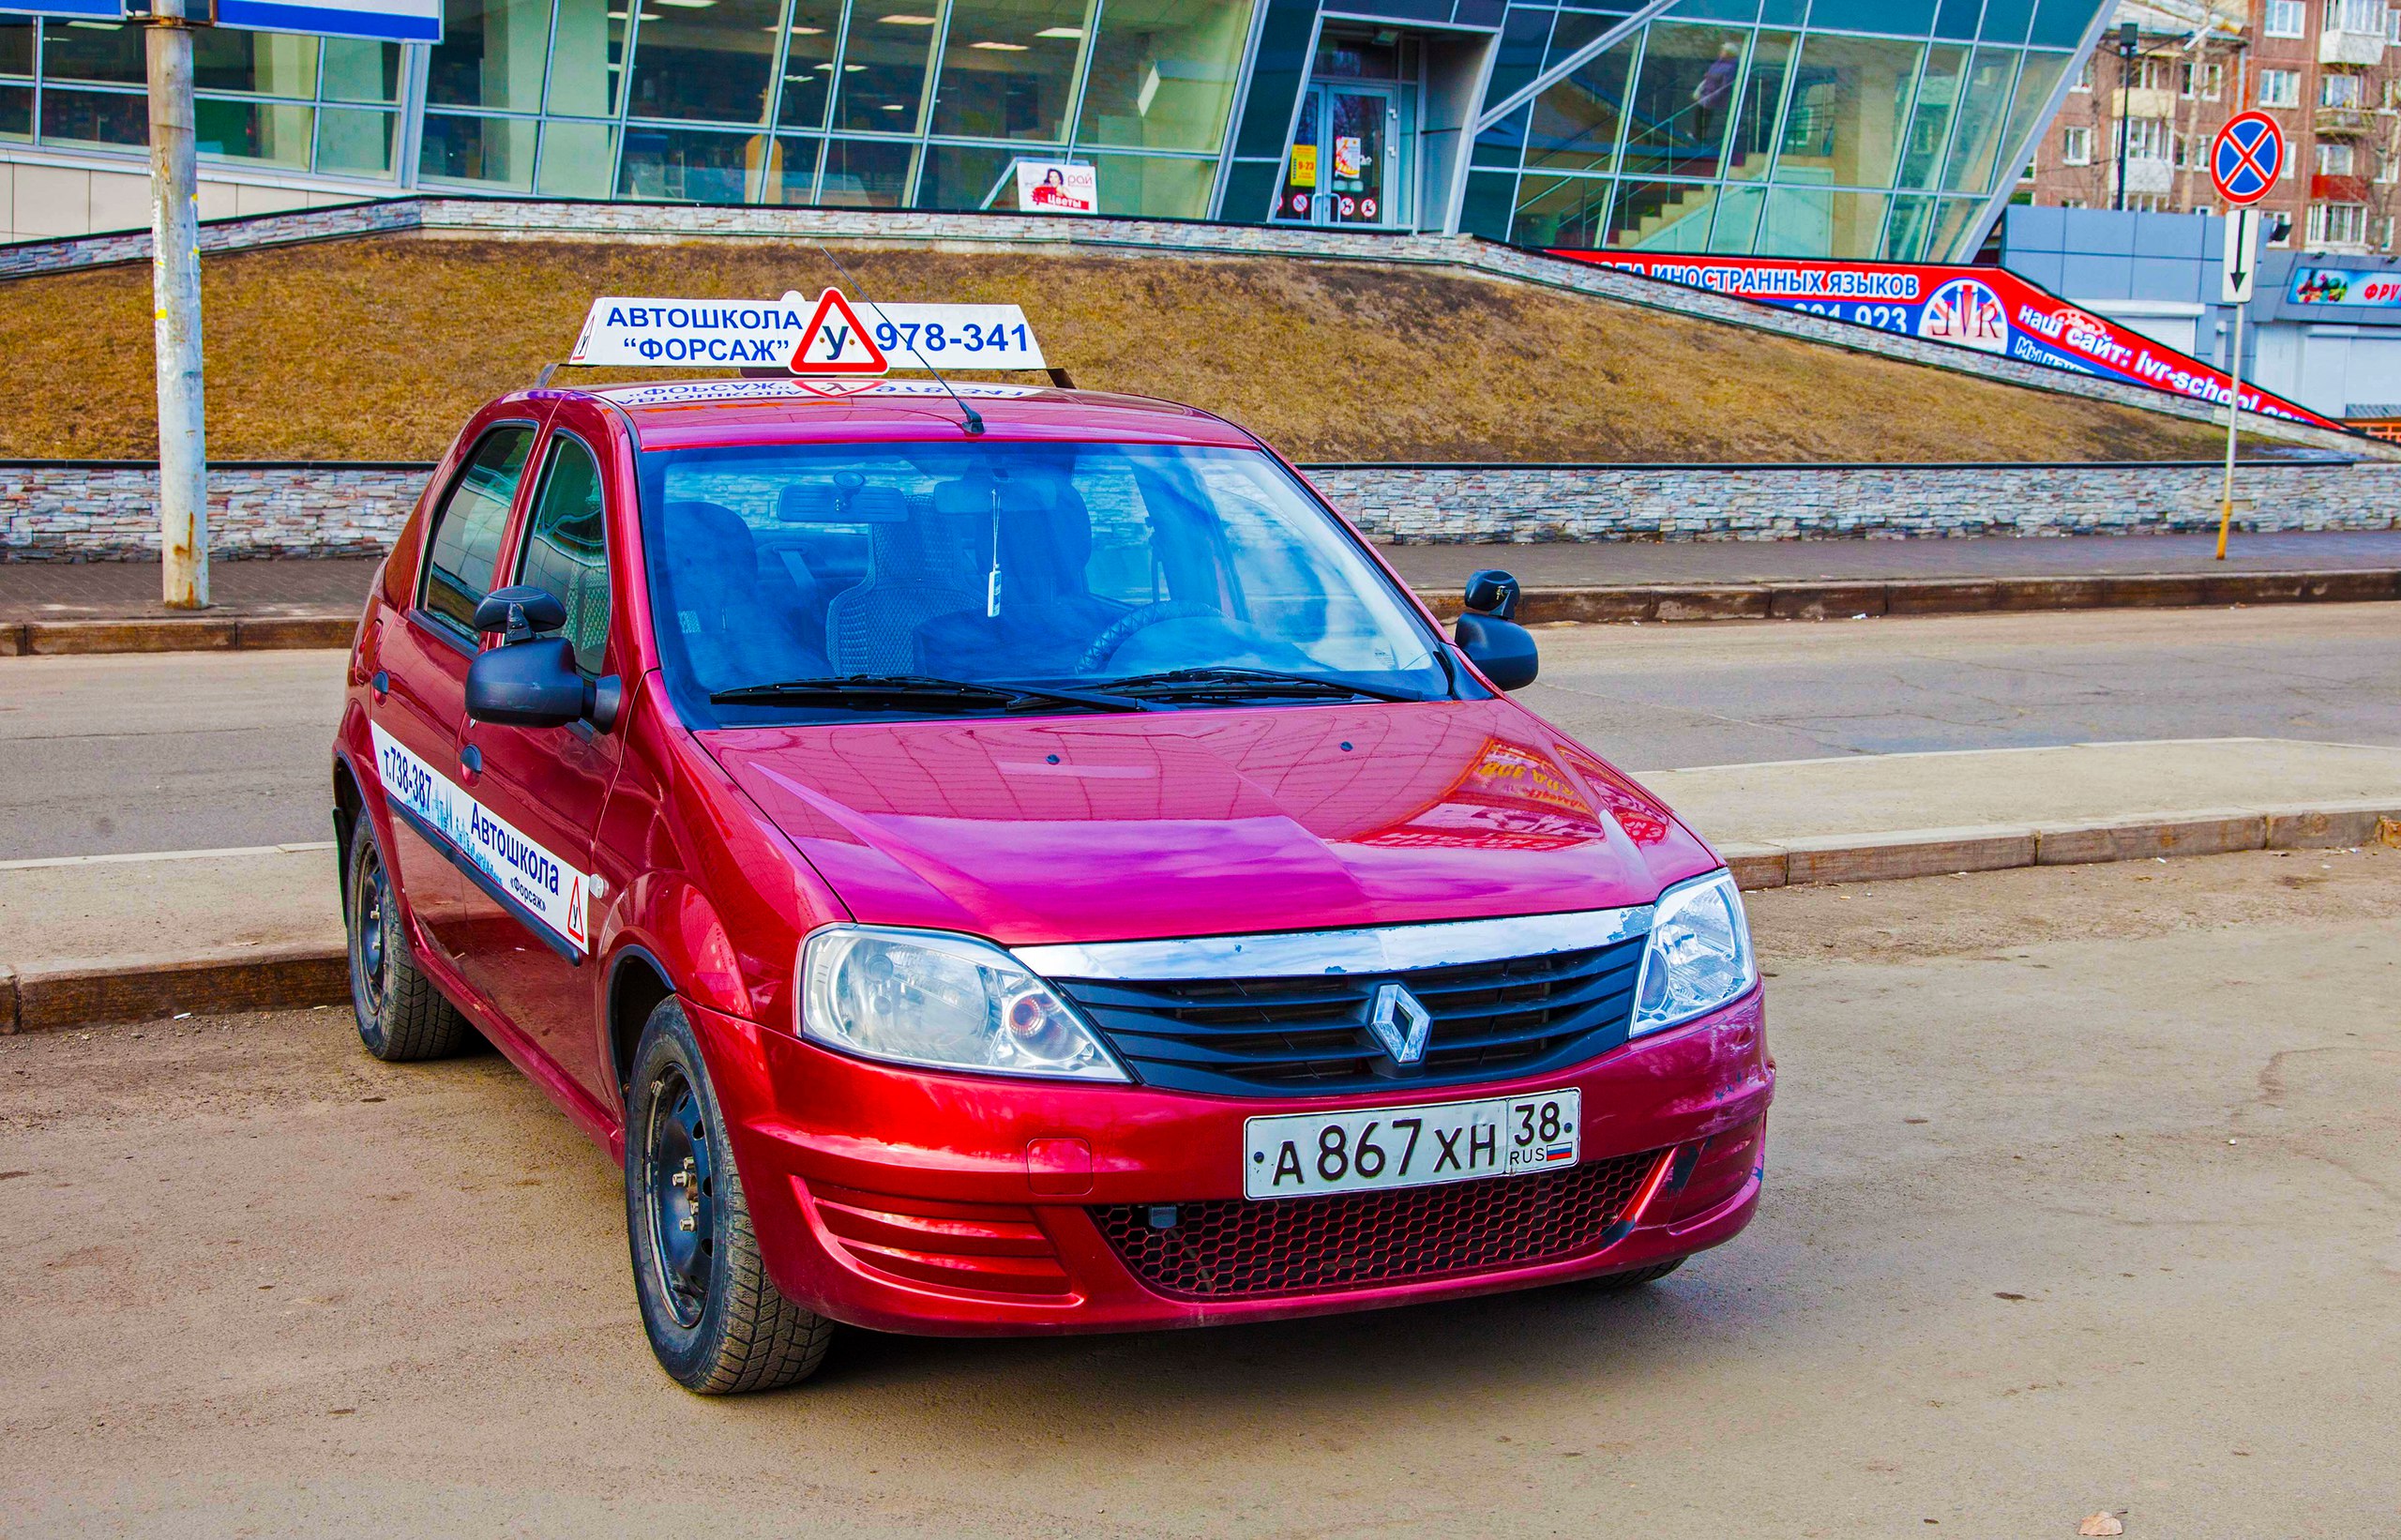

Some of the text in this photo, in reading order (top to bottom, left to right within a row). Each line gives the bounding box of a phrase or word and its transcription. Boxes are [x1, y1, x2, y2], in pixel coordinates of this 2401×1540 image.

[1048, 193, 1081, 208] Цветы
[1652, 264, 1825, 294] ИНОСТРАННЫХ
[1827, 271, 1920, 299] ЯЗЫКОВ
[2363, 283, 2401, 301] ФРУ
[606, 307, 804, 330] АВТОШКОЛА
[1854, 305, 1908, 333] 923
[875, 323, 1028, 353] 978-341
[2065, 328, 2134, 368] сайт:
[470, 802, 559, 896] Автошкола
[1513, 1100, 1561, 1148] 38
[1508, 1147, 1546, 1166] RUS
